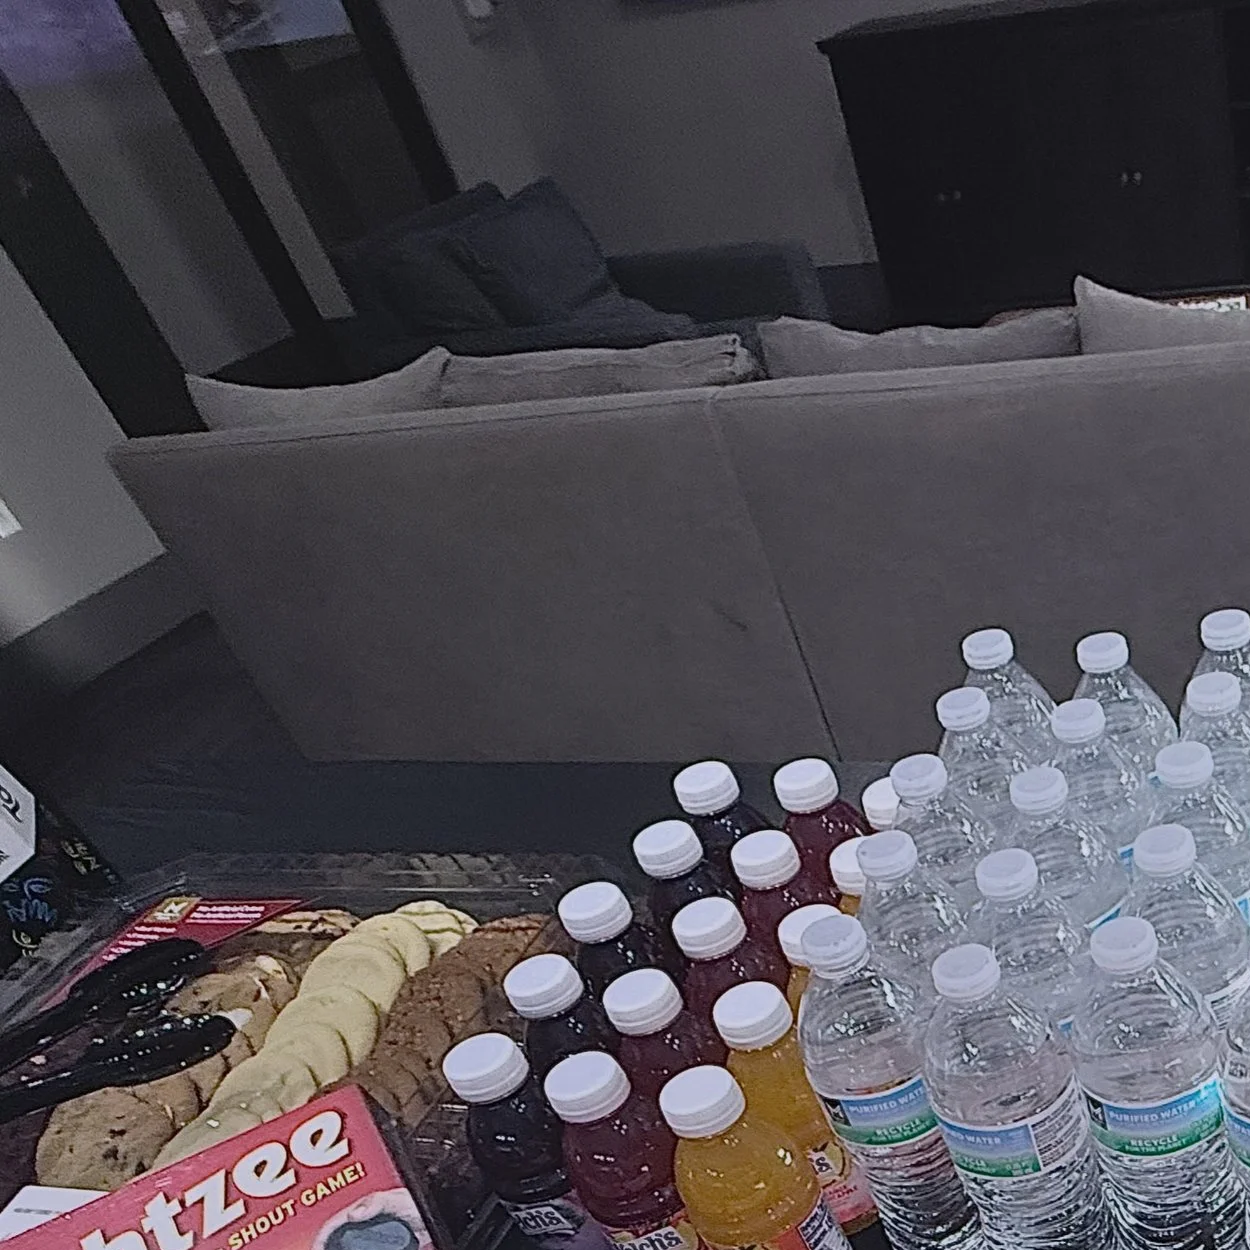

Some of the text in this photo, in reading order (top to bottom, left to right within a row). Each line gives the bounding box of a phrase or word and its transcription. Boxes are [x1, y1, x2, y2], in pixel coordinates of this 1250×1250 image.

[1161, 1100, 1197, 1118] WATER
[300, 1162, 366, 1207] GAME!
[516, 1209, 563, 1230] lch's
